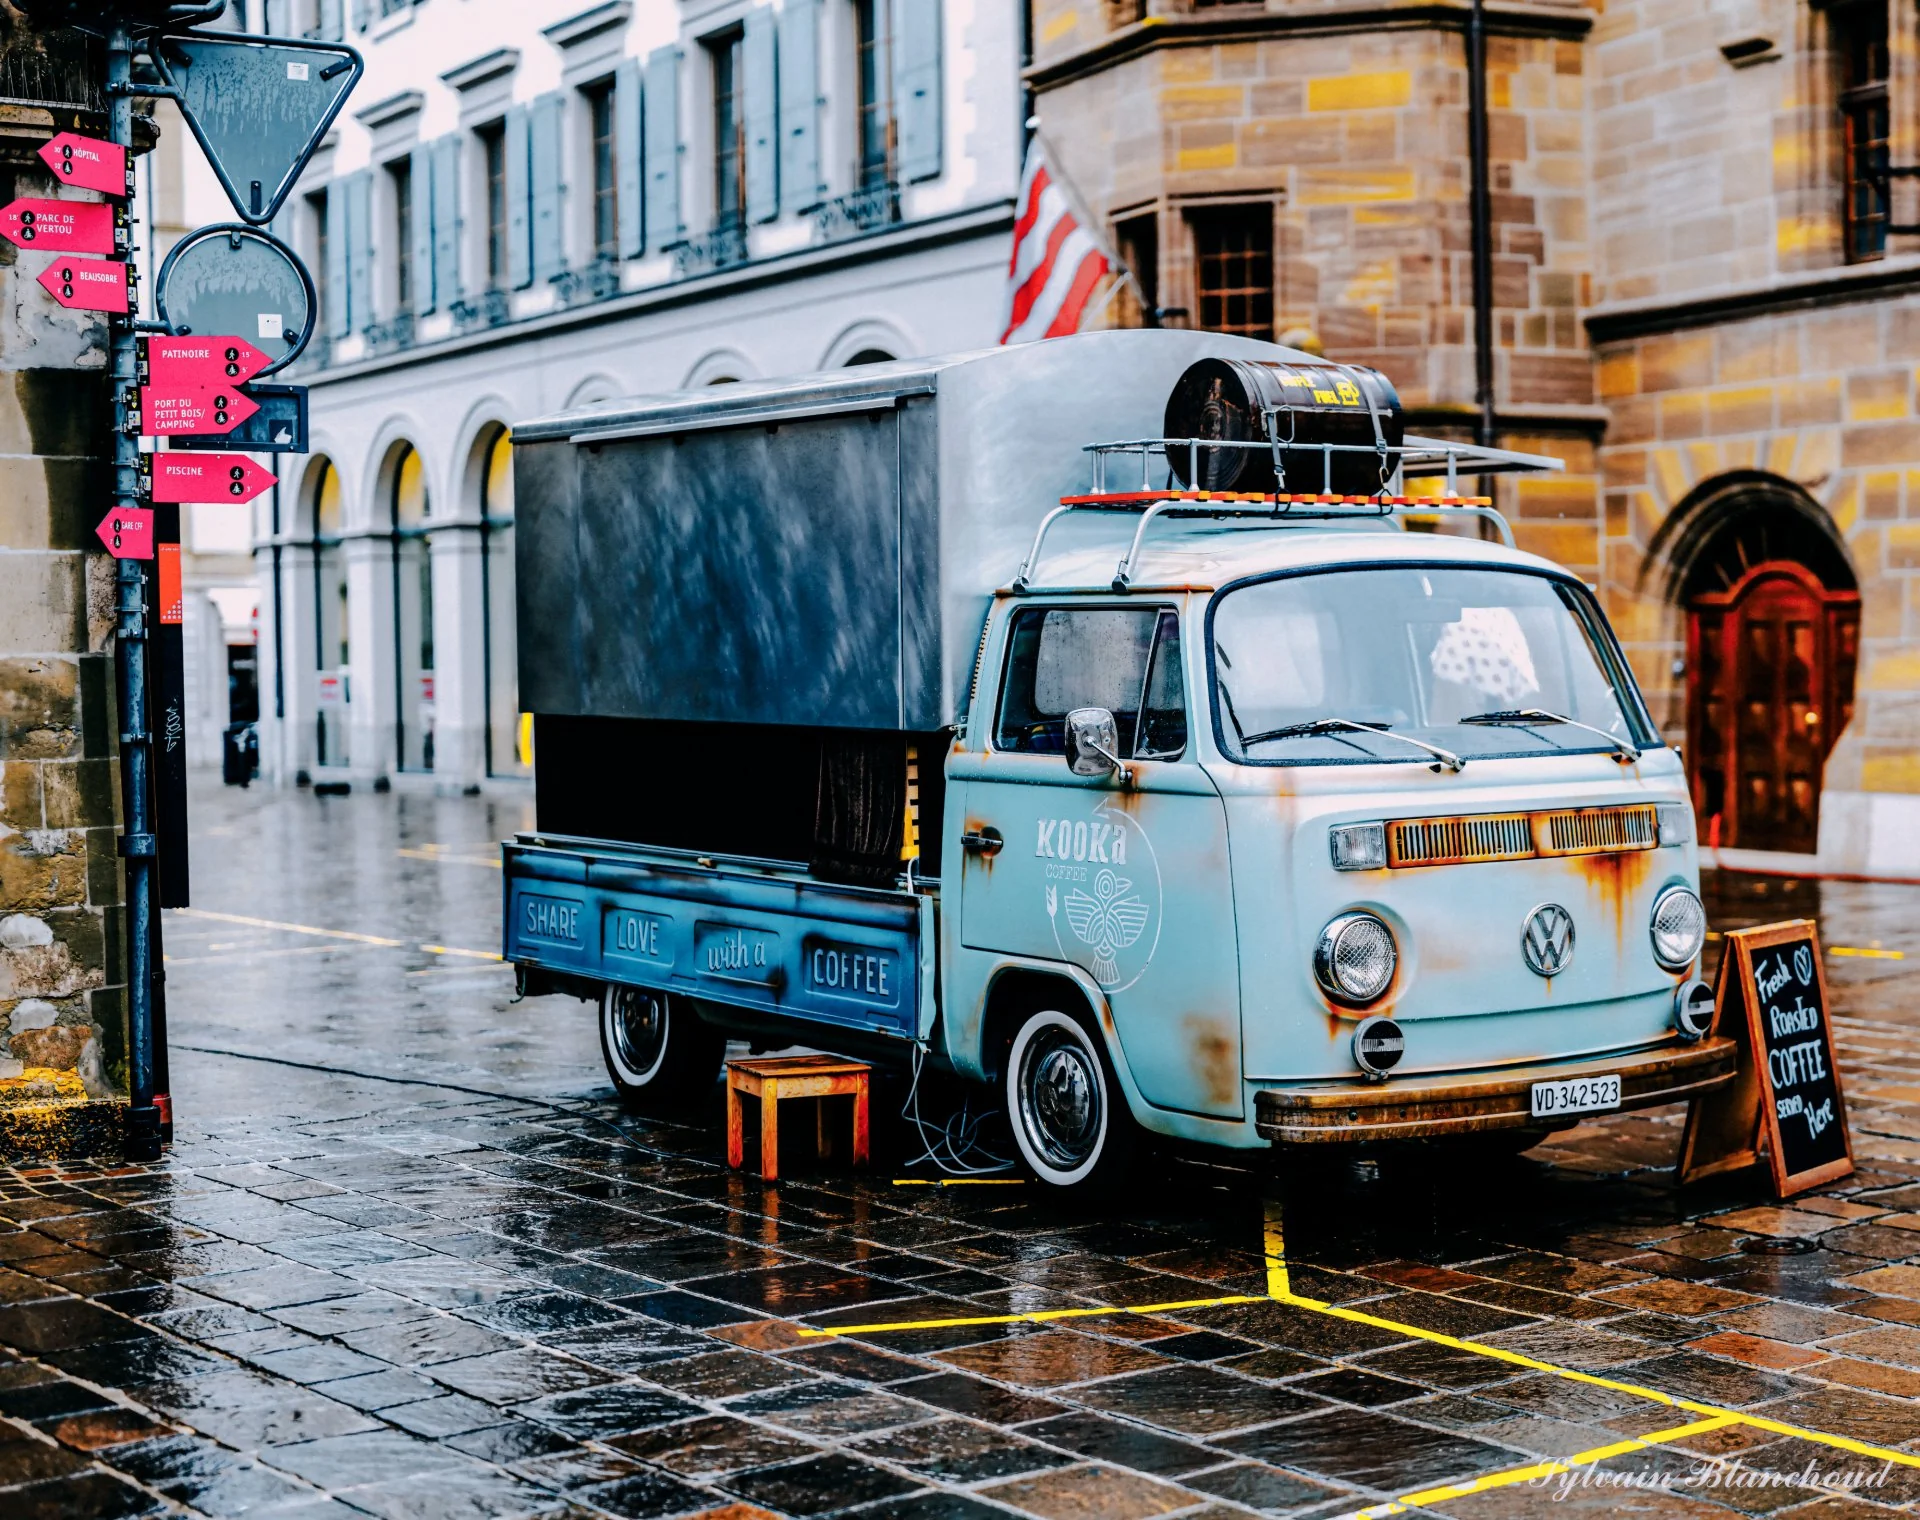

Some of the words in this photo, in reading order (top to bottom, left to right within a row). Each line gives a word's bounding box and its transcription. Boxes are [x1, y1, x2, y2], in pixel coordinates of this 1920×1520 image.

[73, 148, 100, 162] HÔPITAL
[36, 213, 60, 223] PARC
[63, 214, 75, 224] DE
[37, 224, 72, 235] VERTOU
[80, 271, 118, 284] BEAUSOBRE
[162, 349, 210, 359] PATINOIRE
[155, 399, 176, 408] PORT
[179, 398, 192, 407] DU
[155, 410, 178, 419] PETIT
[181, 408, 206, 418] BOIS/
[155, 420, 195, 429] CAMPING
[166, 466, 203, 476] PISCINE
[121, 521, 134, 530] GARE
[134, 522, 144, 531] CFF
[1045, 863, 1088, 882] COFFEE
[527, 901, 578, 940] SHARE
[617, 915, 659, 955] LOVE
[708, 929, 748, 971] with
[754, 940, 766, 967] a
[813, 948, 889, 996] COFFEE
[1768, 1039, 1827, 1090] COFFEE
